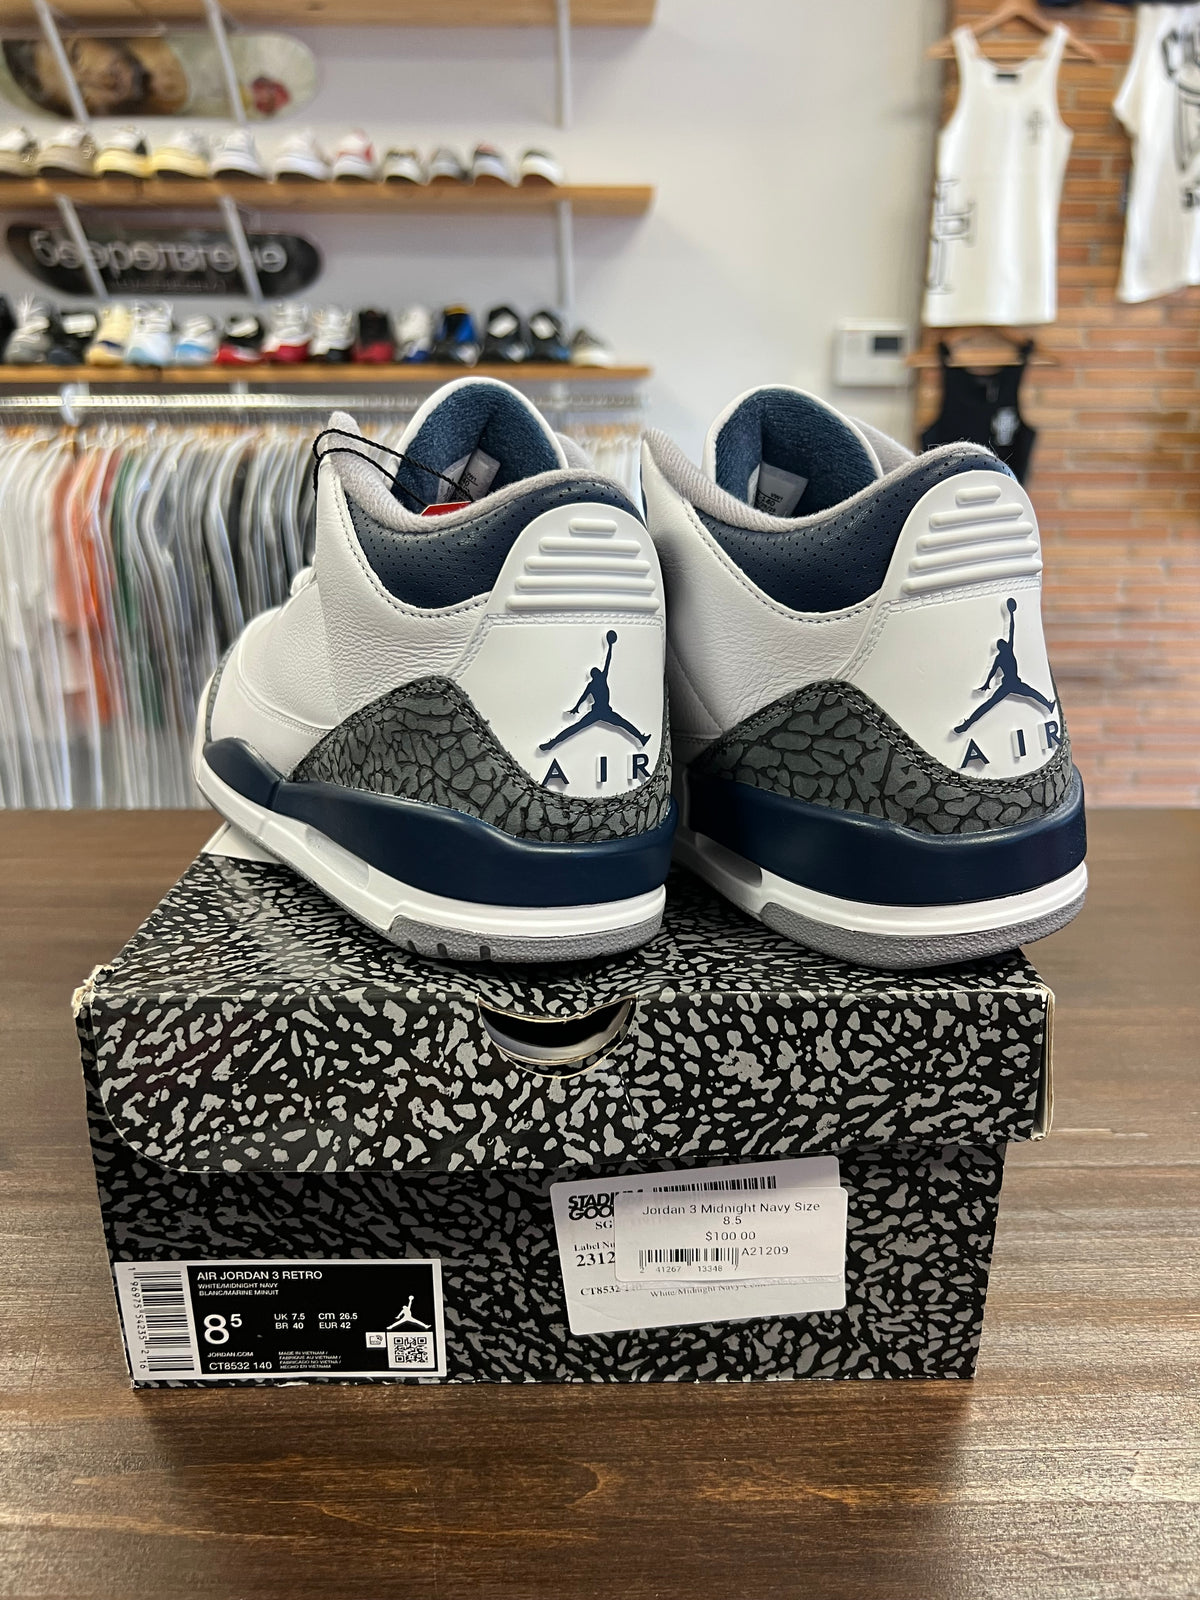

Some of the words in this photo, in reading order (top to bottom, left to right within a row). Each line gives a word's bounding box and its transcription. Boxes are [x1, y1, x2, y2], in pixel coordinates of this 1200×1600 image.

[959, 720, 1063, 769] AIR
[541, 753, 651, 787] AIR
[643, 1204, 685, 1215] Jordan
[689, 1204, 697, 1214] 3
[701, 1203, 756, 1215] Midnight
[760, 1202, 790, 1214] Navy
[794, 1201, 820, 1212] Size
[722, 1215, 742, 1226] 8.5
[574, 1242, 600, 1252] Label
[741, 1245, 789, 1257] A21209
[197, 1271, 217, 1281] AIR
[220, 1271, 269, 1280] JORDAN
[272, 1271, 279, 1280] 3
[282, 1270, 323, 1280] RETRO
[274, 1313, 288, 1321] UK
[339, 1312, 358, 1320] 26.5
[275, 1322, 289, 1330] BR
[292, 1322, 304, 1330] 40
[208, 1361, 250, 1370] CT8532
[252, 1361, 273, 1370] 140
